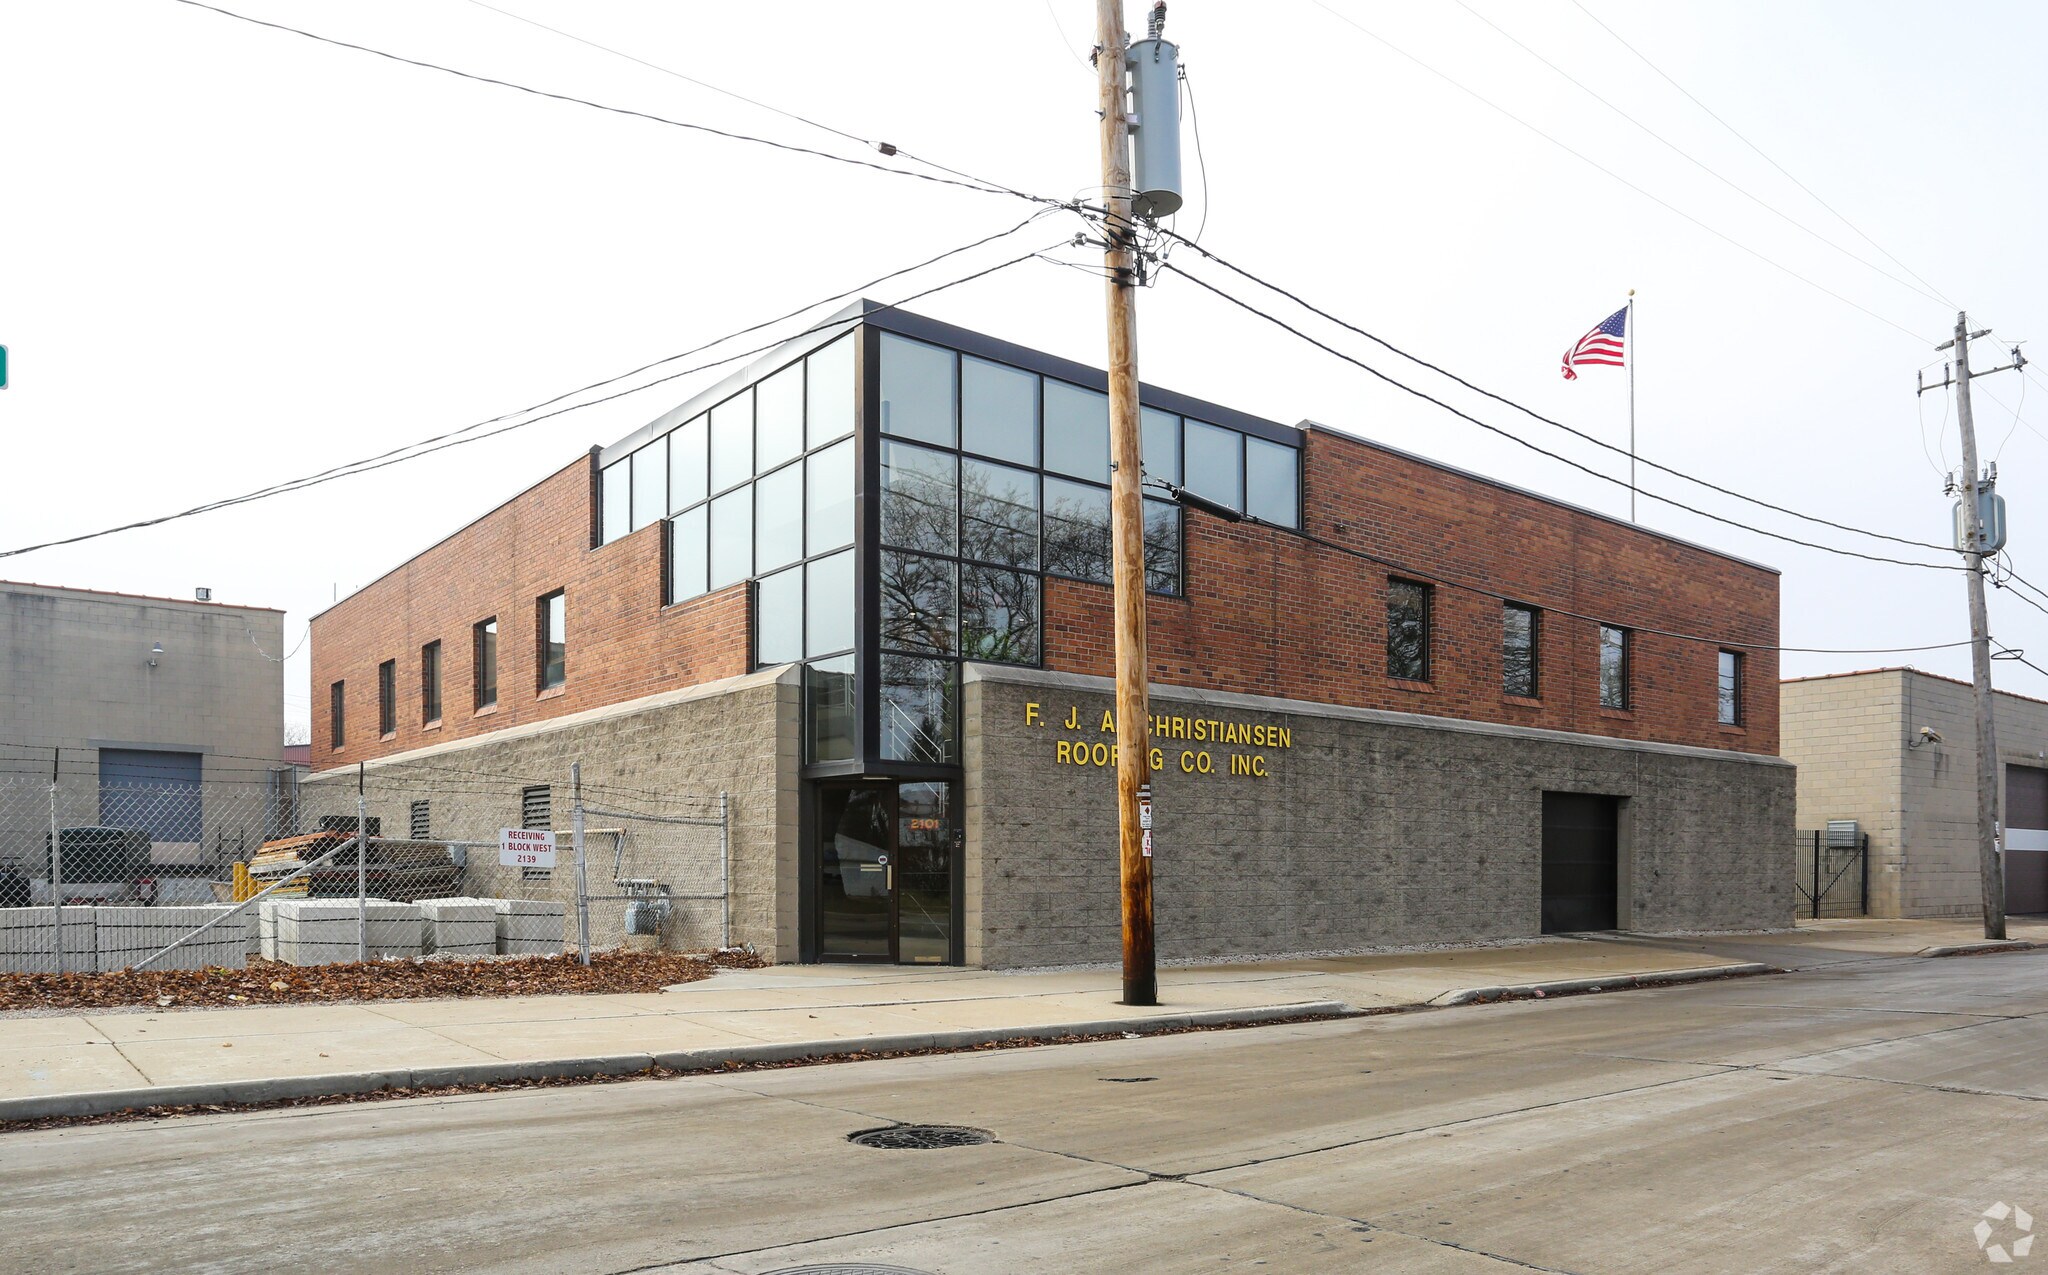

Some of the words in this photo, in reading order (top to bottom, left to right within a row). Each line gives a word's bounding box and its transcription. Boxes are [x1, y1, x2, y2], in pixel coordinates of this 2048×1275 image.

[1026, 702, 1045, 726] F.
[1064, 706, 1081, 730] J.
[1057, 740, 1163, 771] ROOFG
[1180, 750, 1215, 774] CO.
[1231, 753, 1269, 777] INC.
[910, 818, 939, 830] 2101
[508, 831, 545, 840] RECEIVING
[501, 842, 505, 850] 1
[508, 843, 531, 851] BLOCK
[533, 844, 552, 852] WEST
[517, 855, 536, 863] 2139
